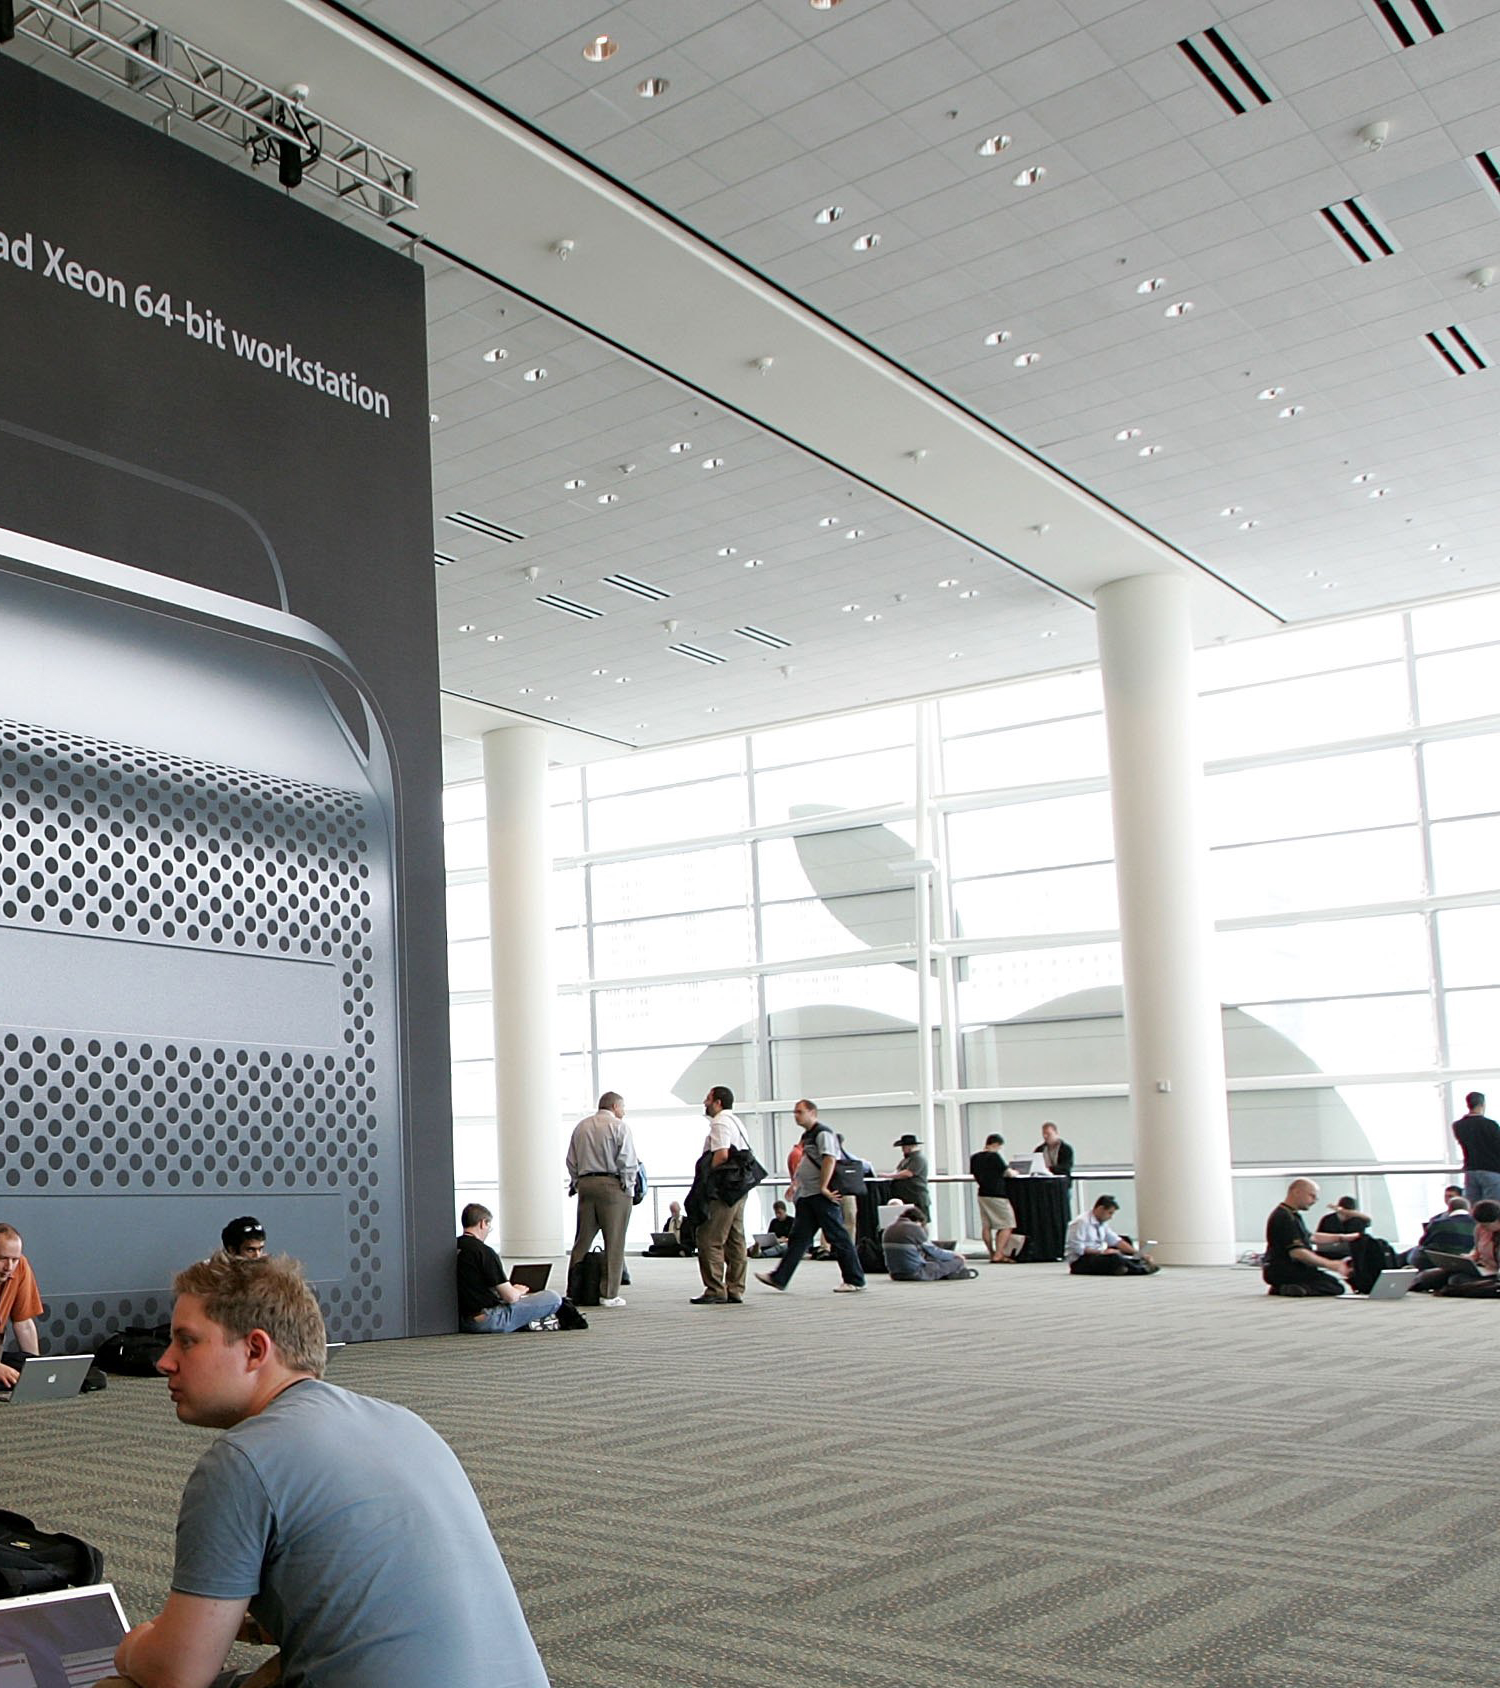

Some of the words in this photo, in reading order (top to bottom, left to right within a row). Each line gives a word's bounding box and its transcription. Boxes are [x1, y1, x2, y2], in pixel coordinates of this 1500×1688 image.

[42, 240, 126, 309] Xeon
[134, 284, 226, 350] 64-bit
[232, 329, 390, 419] workstation
